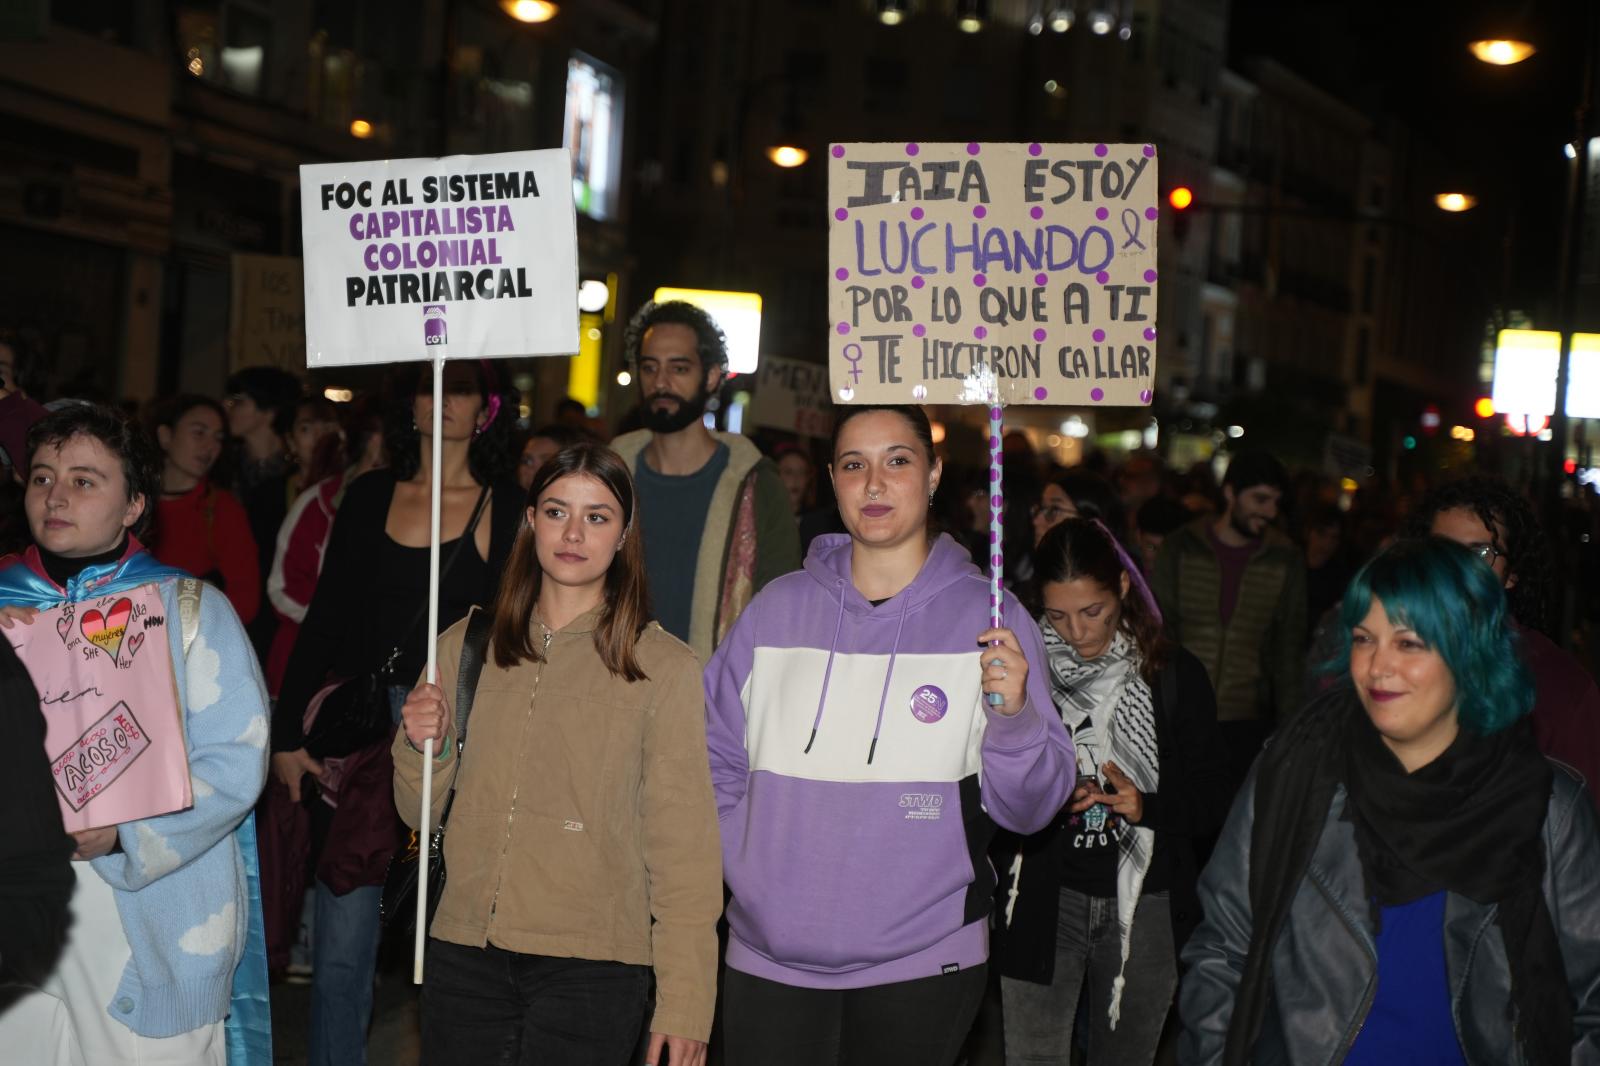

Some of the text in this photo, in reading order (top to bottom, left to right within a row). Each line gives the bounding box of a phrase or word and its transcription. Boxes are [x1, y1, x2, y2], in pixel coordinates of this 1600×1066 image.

[321, 171, 540, 210] FOC AL SISTEMA
[846, 157, 1149, 208] IAIA ESTOY
[350, 205, 515, 240] CAPITALISTA
[364, 238, 502, 271] COLONIAL
[855, 219, 1114, 276] LUCHANDO
[346, 267, 532, 307] PATRIARCAL
[845, 282, 1151, 327] POR LO QUE A TI
[860, 334, 1151, 384] TE HICIERON CALLAR
[83, 647, 99, 660] SHE
[119, 656, 132, 669] Her
[64, 727, 128, 791] ACOSO
[898, 793, 943, 807] STWD
